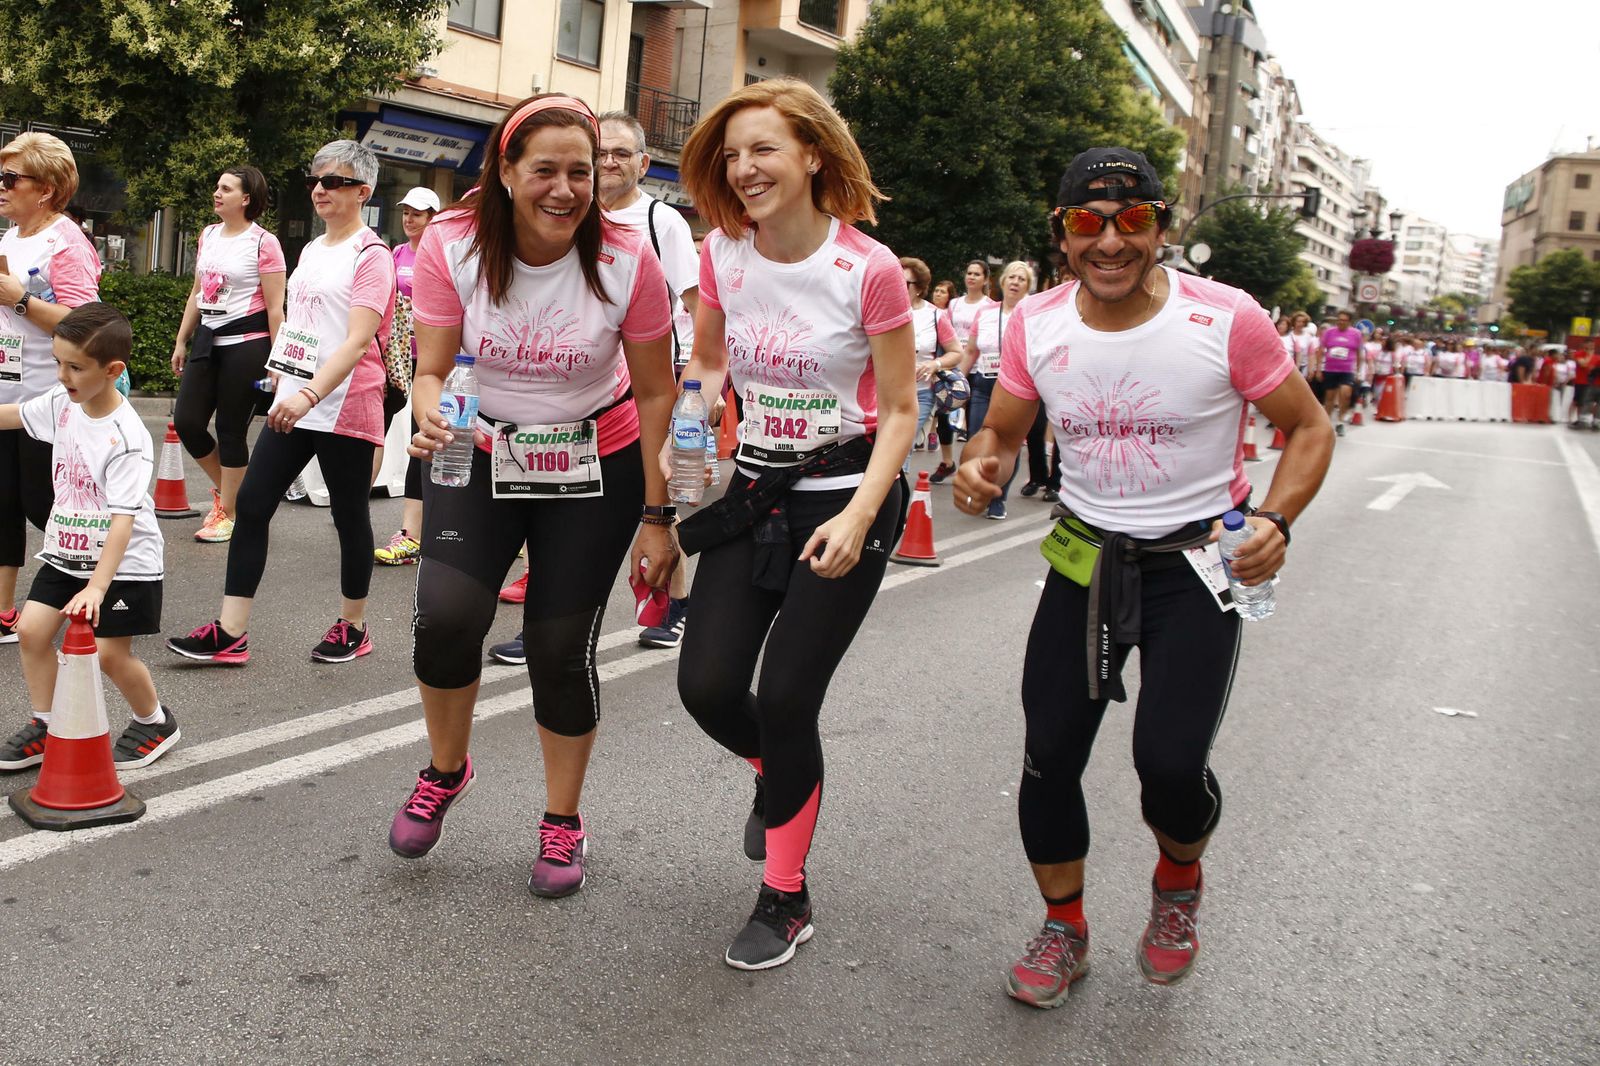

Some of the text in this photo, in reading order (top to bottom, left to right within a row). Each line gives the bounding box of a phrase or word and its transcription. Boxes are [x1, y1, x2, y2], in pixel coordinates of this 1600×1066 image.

[382, 129, 429, 144] AUTOCARES
[286, 330, 319, 346] COVIRAN
[283, 342, 305, 361] 2369
[479, 336, 508, 360] Por
[538, 348, 592, 371] mujer
[727, 335, 750, 360] Por
[772, 354, 823, 377] mujer
[758, 393, 838, 411] COVIRAN
[763, 414, 808, 440] 7342
[1061, 417, 1092, 437] Por
[1120, 421, 1177, 445] mujer
[774, 443, 795, 451] LAURA
[525, 451, 570, 472] 1100
[53, 513, 112, 529] COVIRAN
[58, 530, 90, 551] 3272
[1051, 529, 1071, 547] trail
